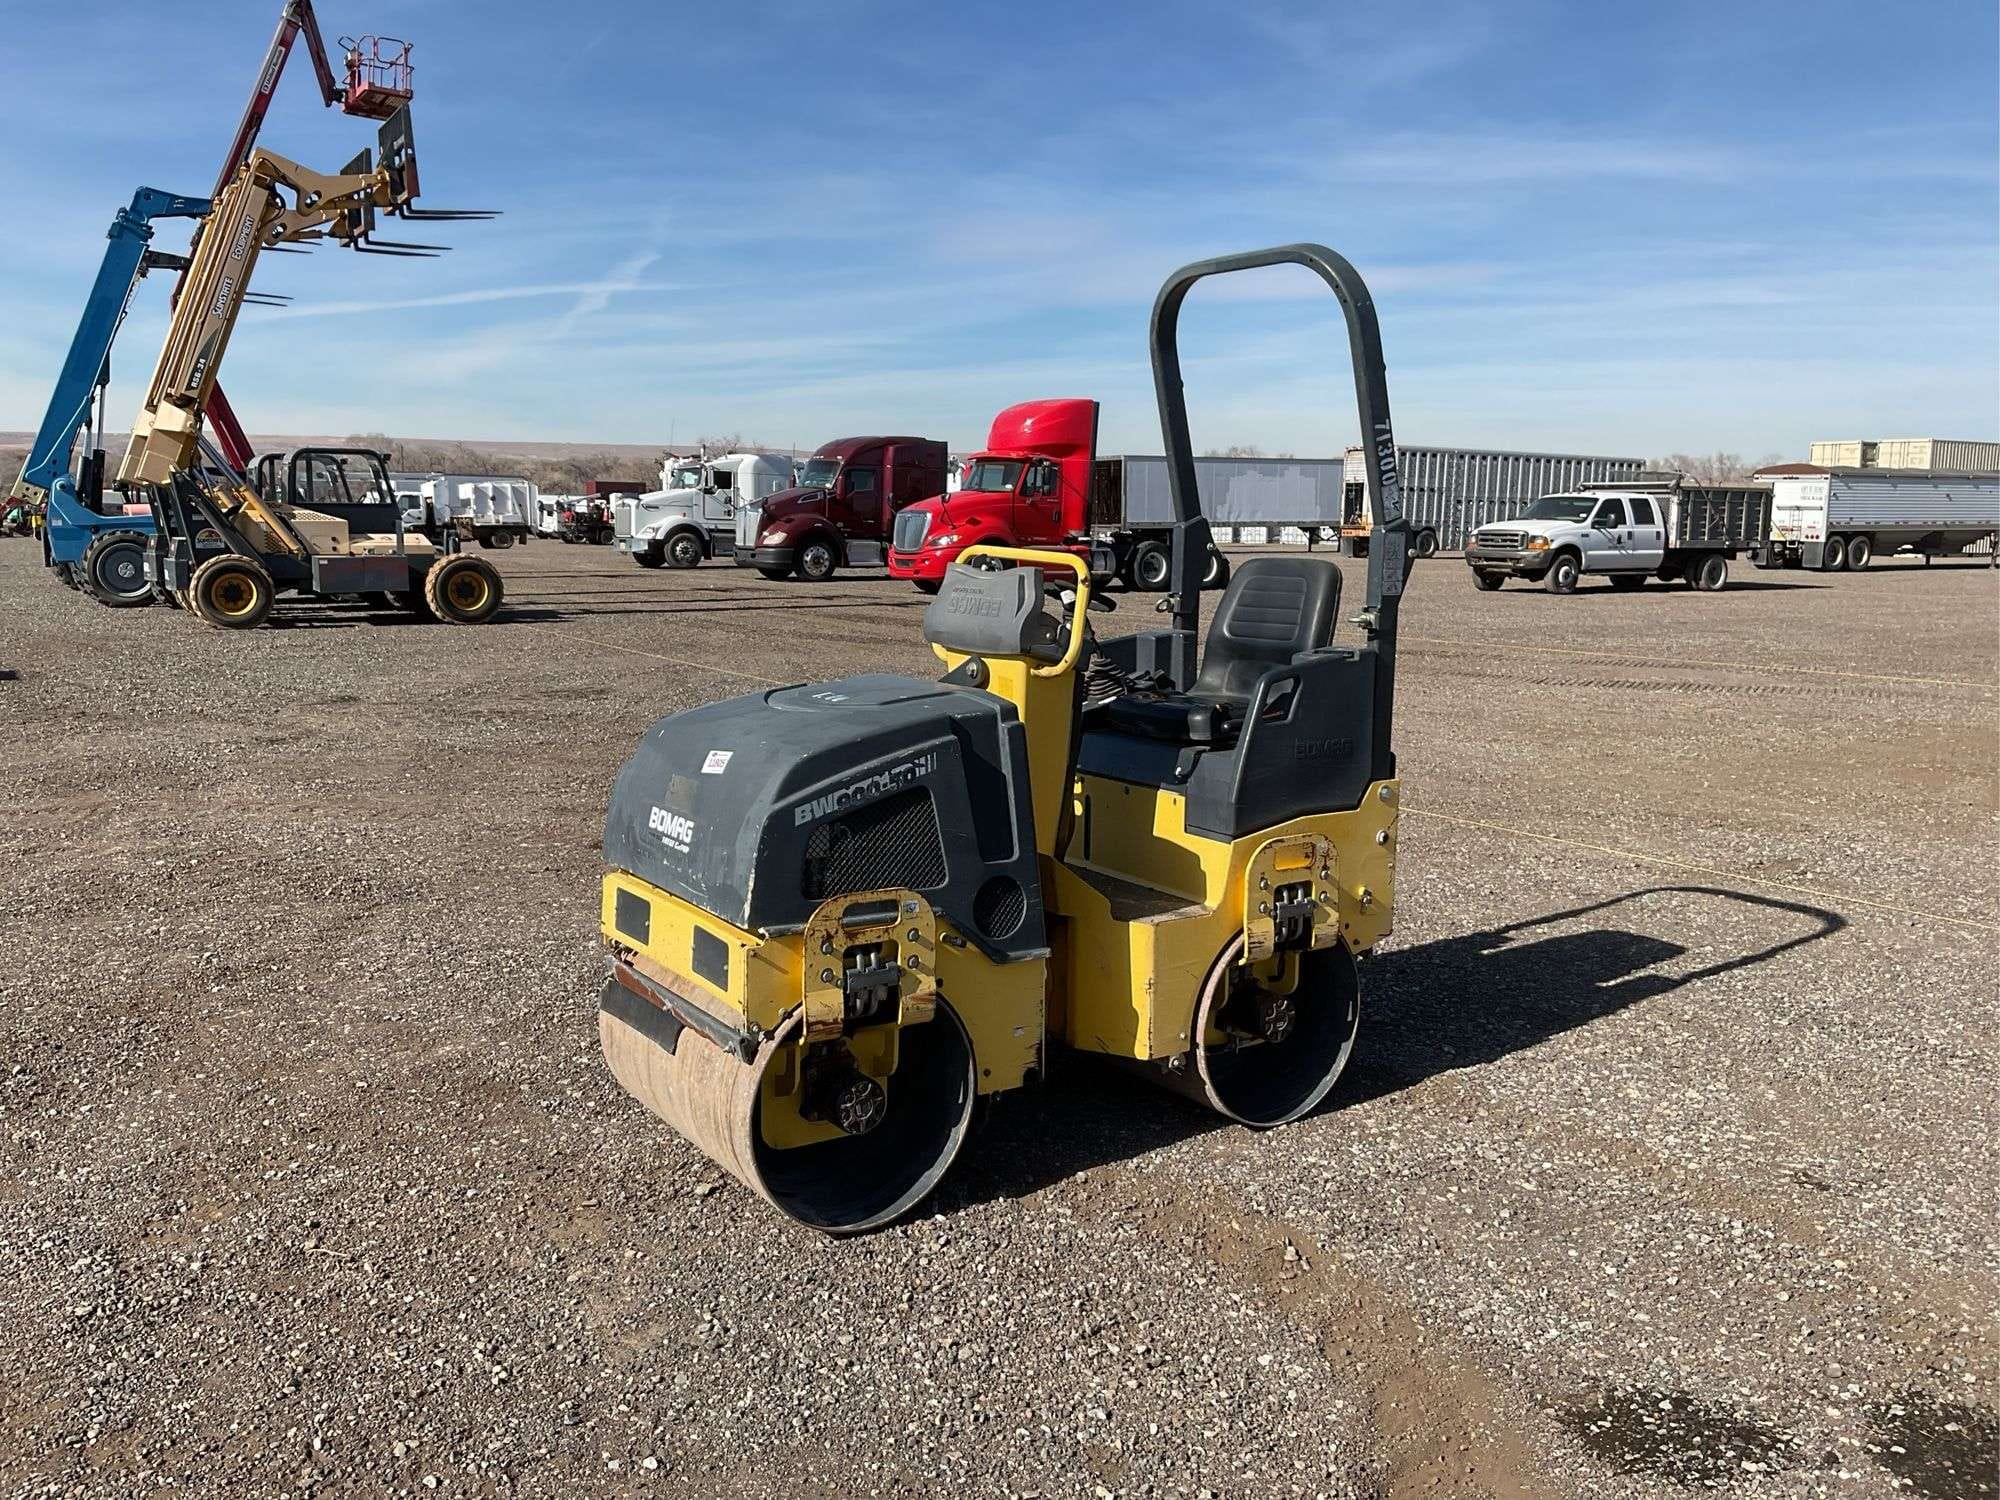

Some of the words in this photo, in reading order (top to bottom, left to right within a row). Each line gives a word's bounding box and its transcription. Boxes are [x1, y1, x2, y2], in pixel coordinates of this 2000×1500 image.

[212, 276, 233, 319] SUNSTATE
[232, 215, 254, 260] EQUIPMENT
[648, 805, 695, 844] BOMAG
